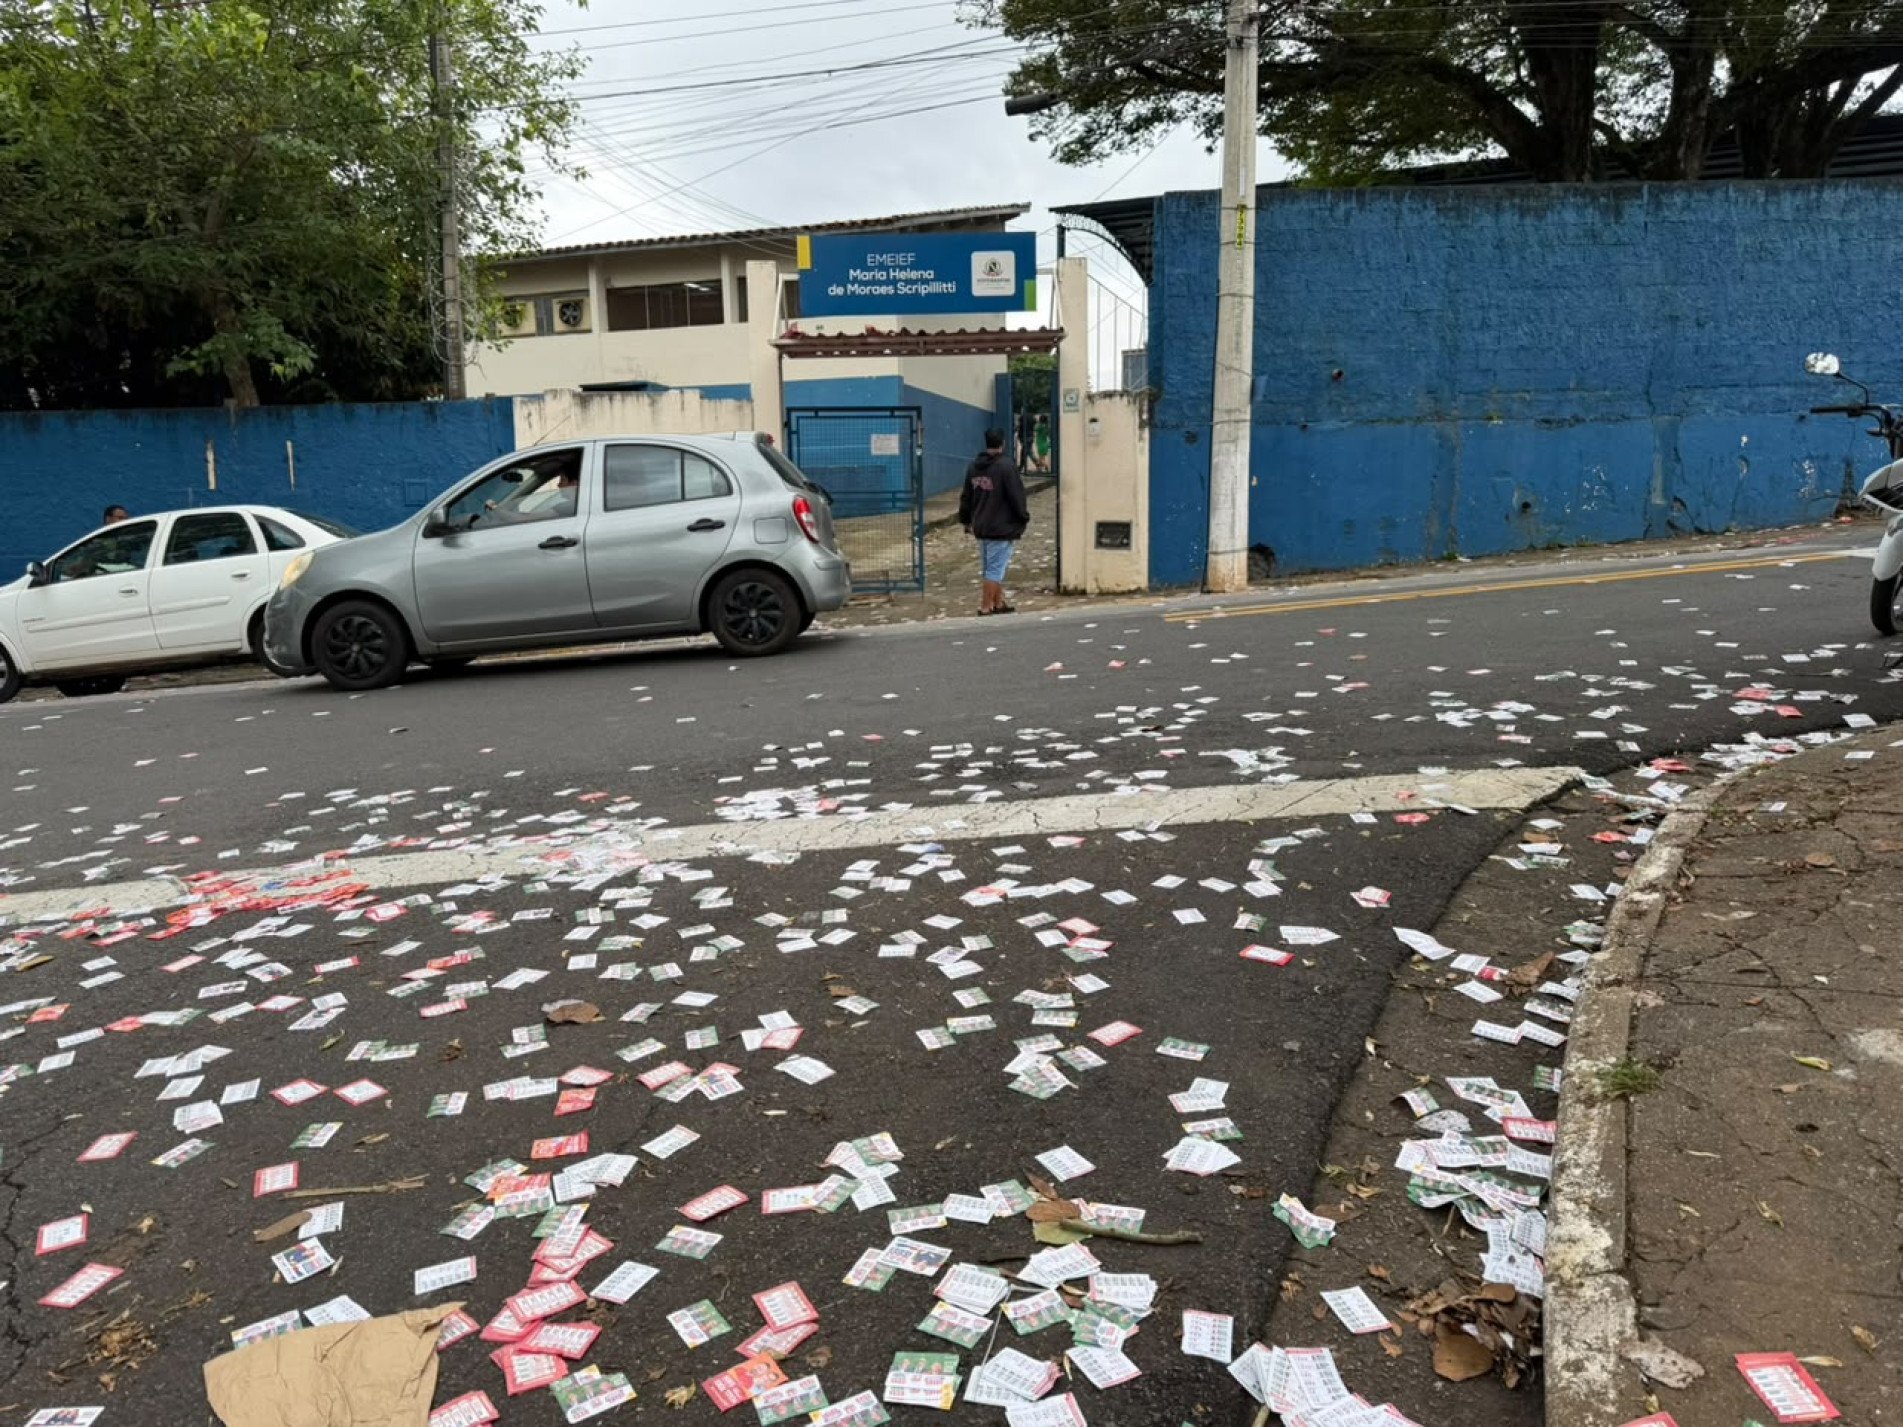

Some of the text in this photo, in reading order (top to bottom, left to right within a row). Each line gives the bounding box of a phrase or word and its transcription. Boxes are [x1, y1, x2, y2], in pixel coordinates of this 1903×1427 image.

[867, 253, 916, 266] EMEIEF
[849, 267, 934, 281] Maria Helena
[828, 284, 844, 295] de
[847, 283, 894, 295] Moraes
